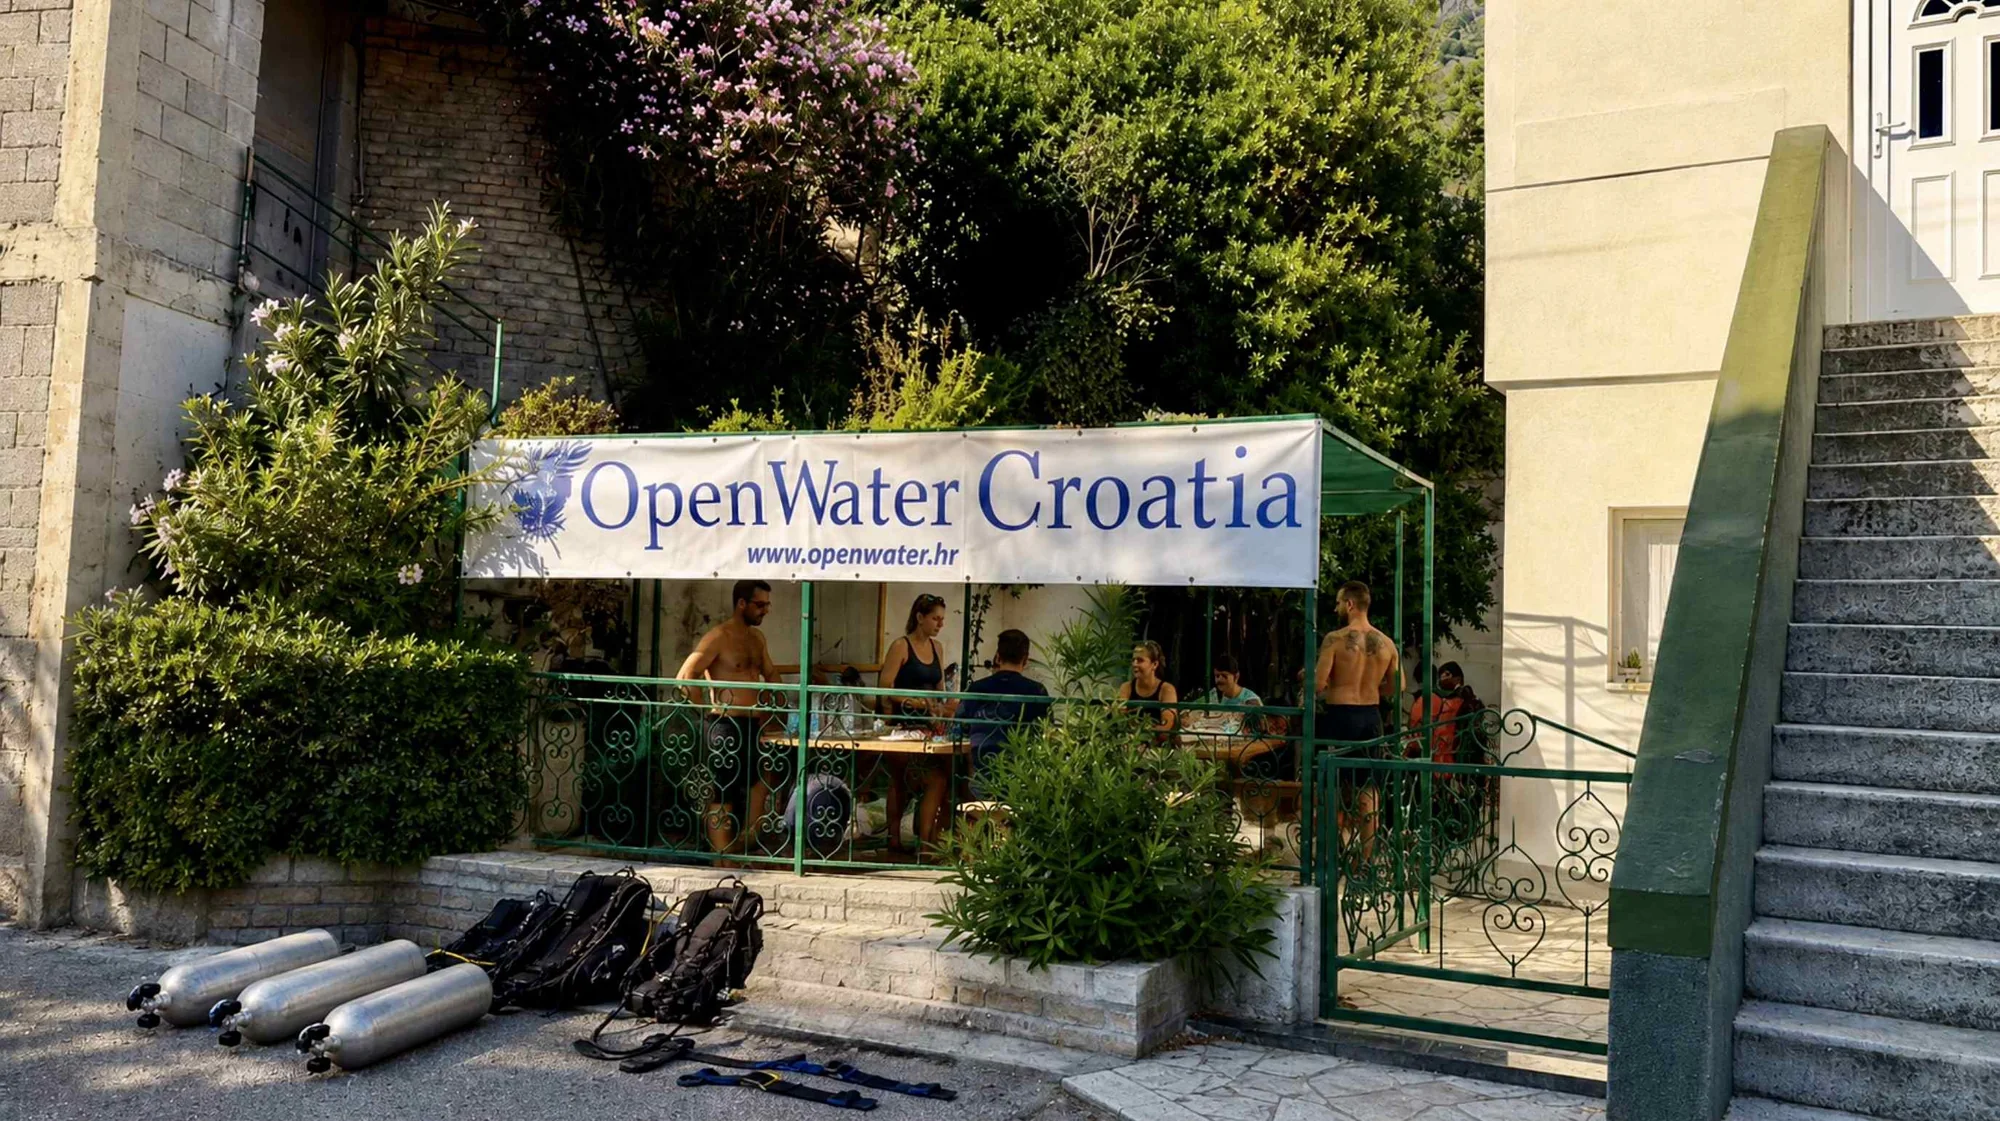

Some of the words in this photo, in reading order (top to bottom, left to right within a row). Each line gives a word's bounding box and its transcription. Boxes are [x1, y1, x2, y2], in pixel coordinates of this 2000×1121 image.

[581, 459, 960, 551] OpenWater
[978, 445, 1302, 532] Croatia
[747, 542, 959, 570] www.openwater.hr
